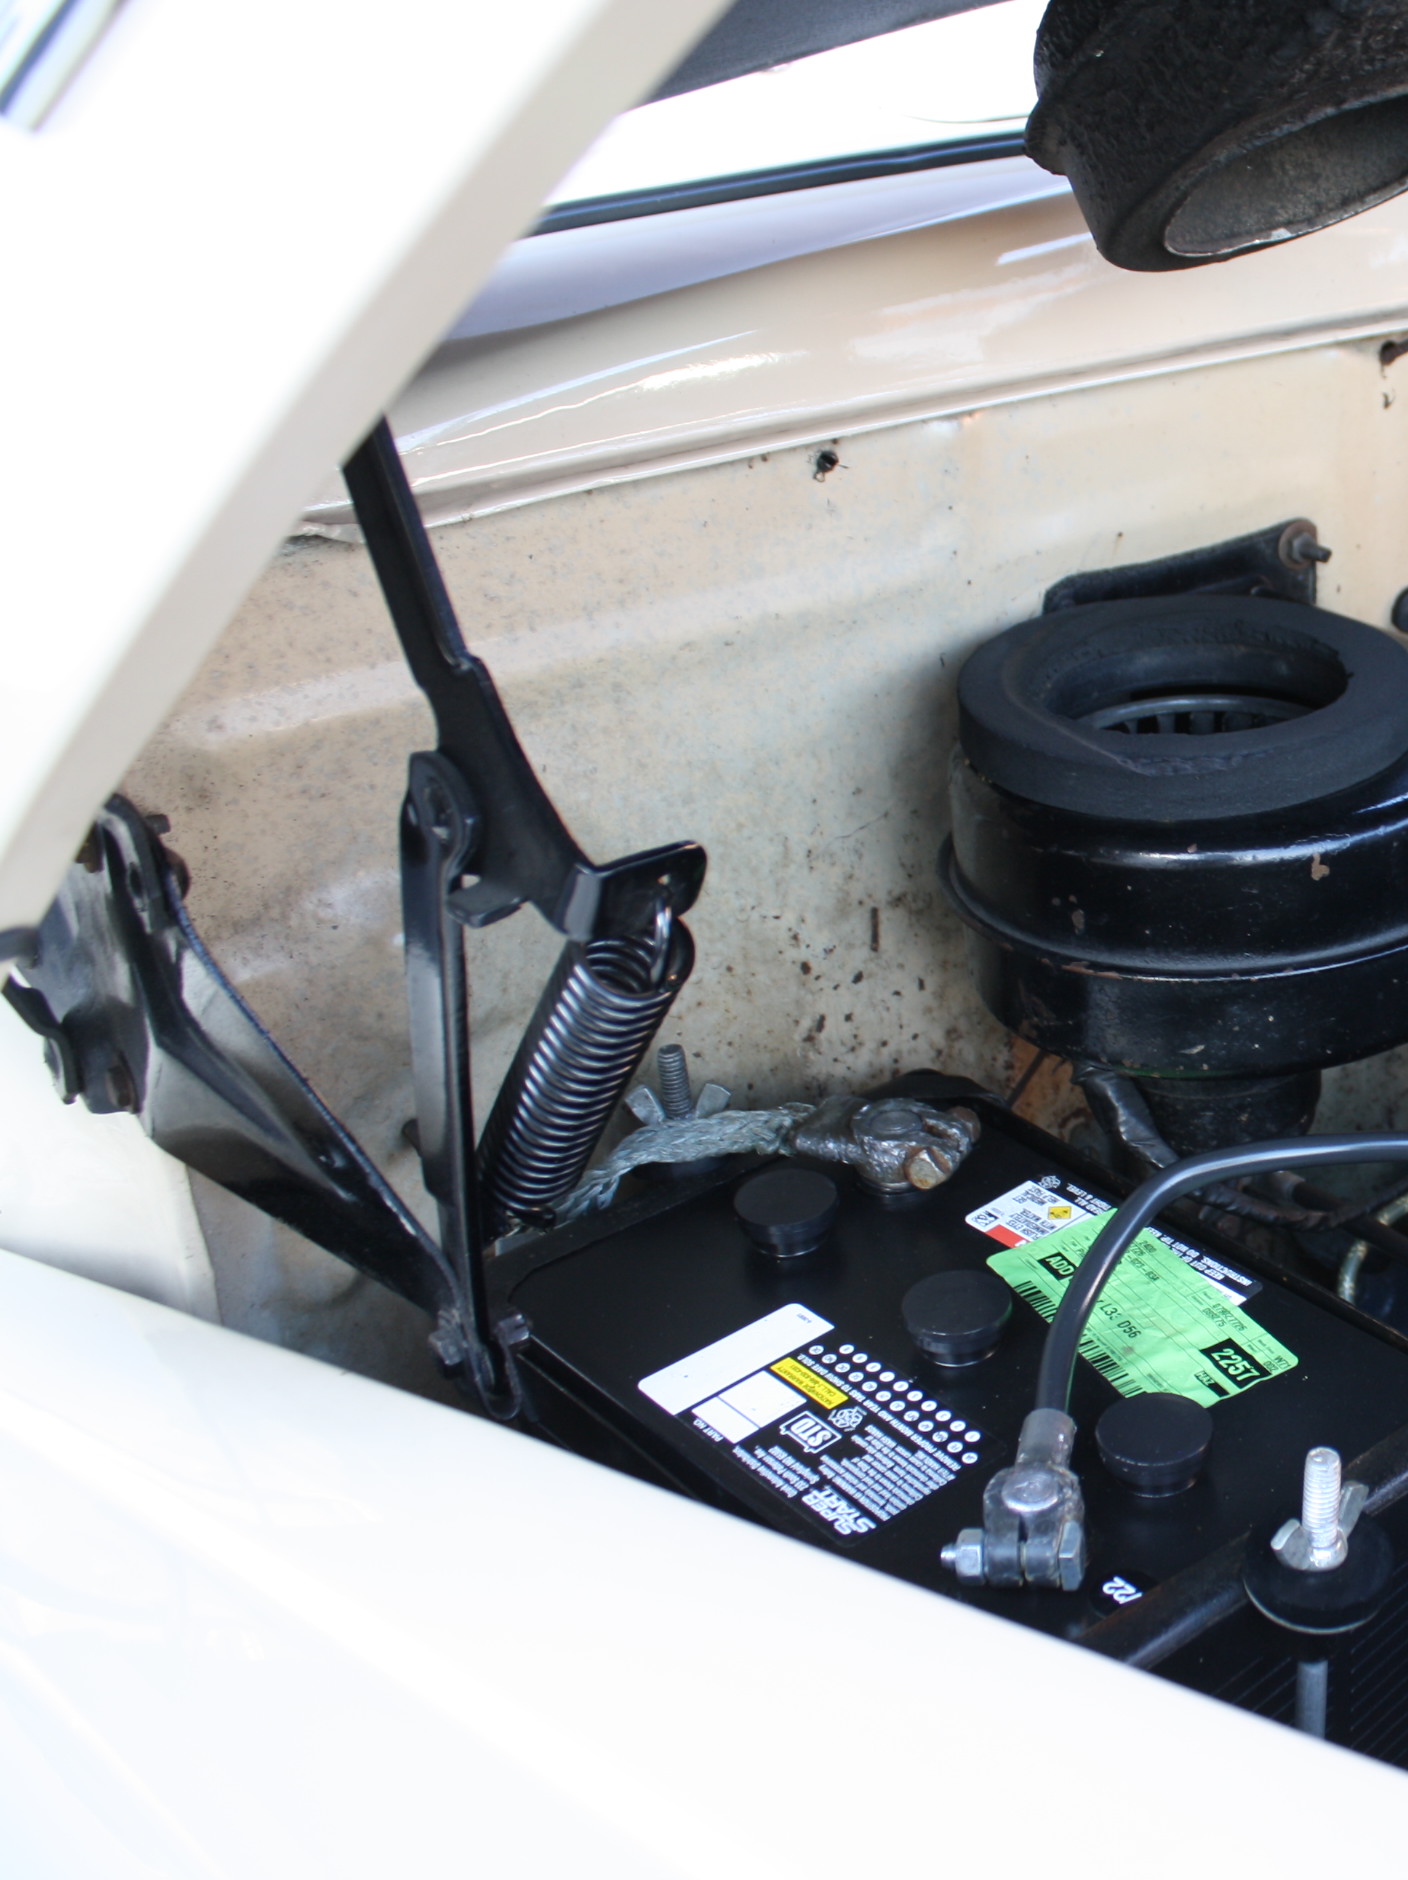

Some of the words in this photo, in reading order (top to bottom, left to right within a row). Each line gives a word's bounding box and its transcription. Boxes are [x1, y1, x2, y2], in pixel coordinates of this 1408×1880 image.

[1004, 1219, 1024, 1230] EYES
[1171, 1242, 1189, 1252] NOT
[1186, 1249, 1199, 1258] DO
[1045, 1255, 1074, 1276] ADD
[1189, 1261, 1208, 1271] OUT
[1200, 1256, 1252, 1286] INSTRUCTIONS.
[1204, 1269, 1225, 1280] KEEP
[1117, 1320, 1142, 1338] D56
[1211, 1348, 1261, 1381] 2257
[1196, 1369, 1216, 1386] HAZ
[693, 1417, 708, 1429] NO.
[790, 1417, 832, 1446] STD
[703, 1427, 725, 1442] PART
[801, 1491, 852, 1536] SUPER
[816, 1485, 878, 1534] START
